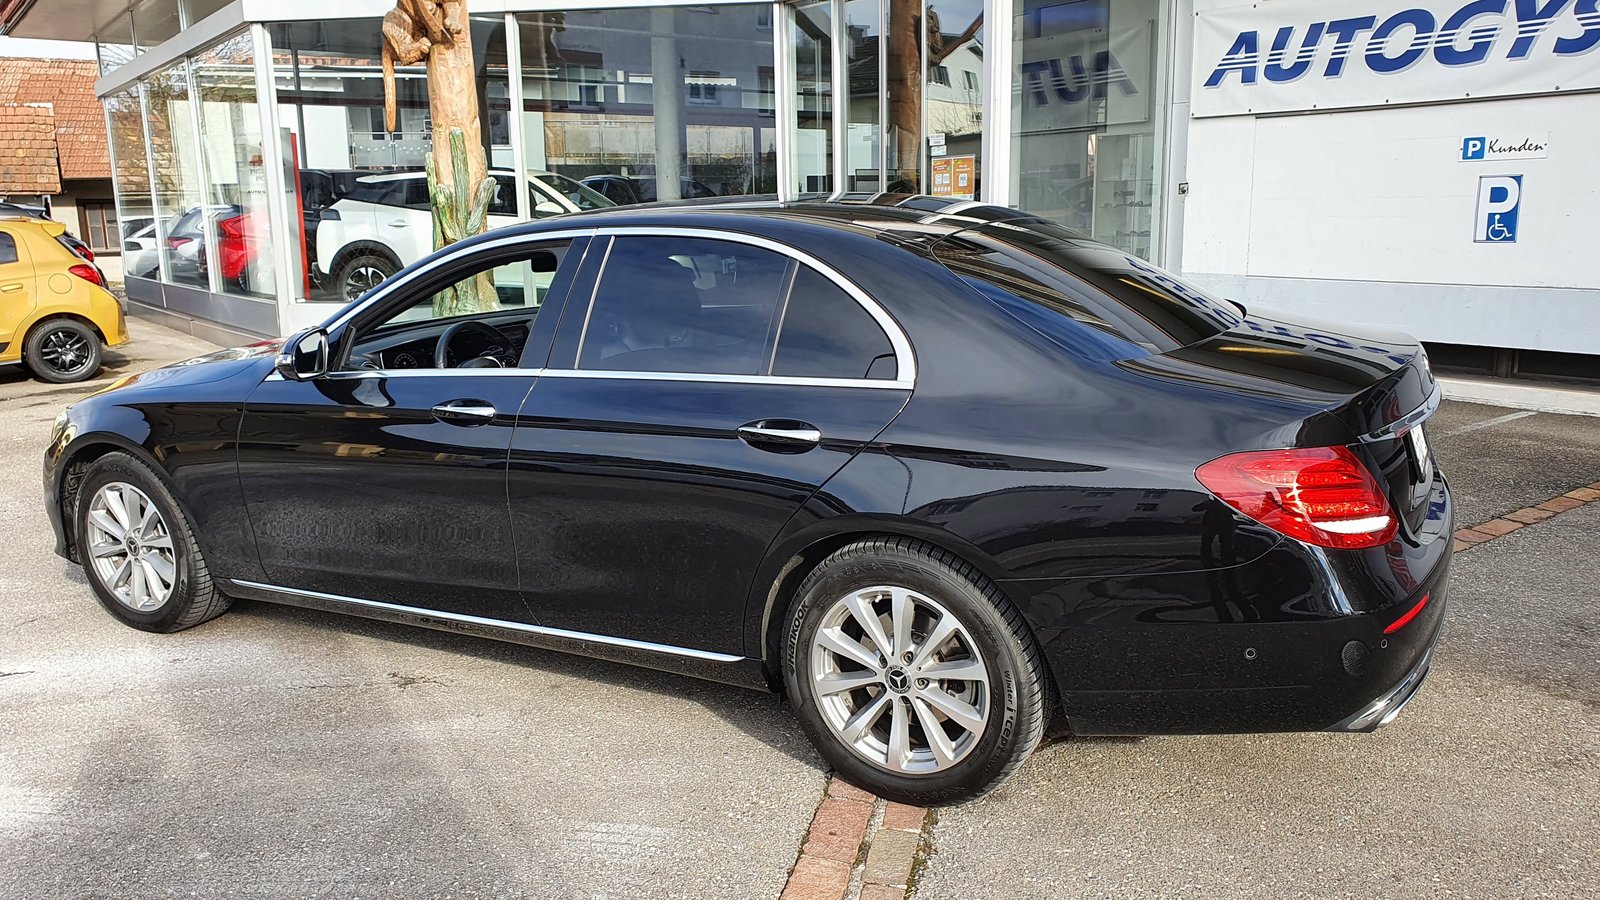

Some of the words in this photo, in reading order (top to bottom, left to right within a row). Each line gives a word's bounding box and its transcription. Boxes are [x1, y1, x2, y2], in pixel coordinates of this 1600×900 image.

[1467, 140, 1482, 157] P
[1488, 138, 1544, 153] Kunden
[1475, 176, 1520, 240] P
